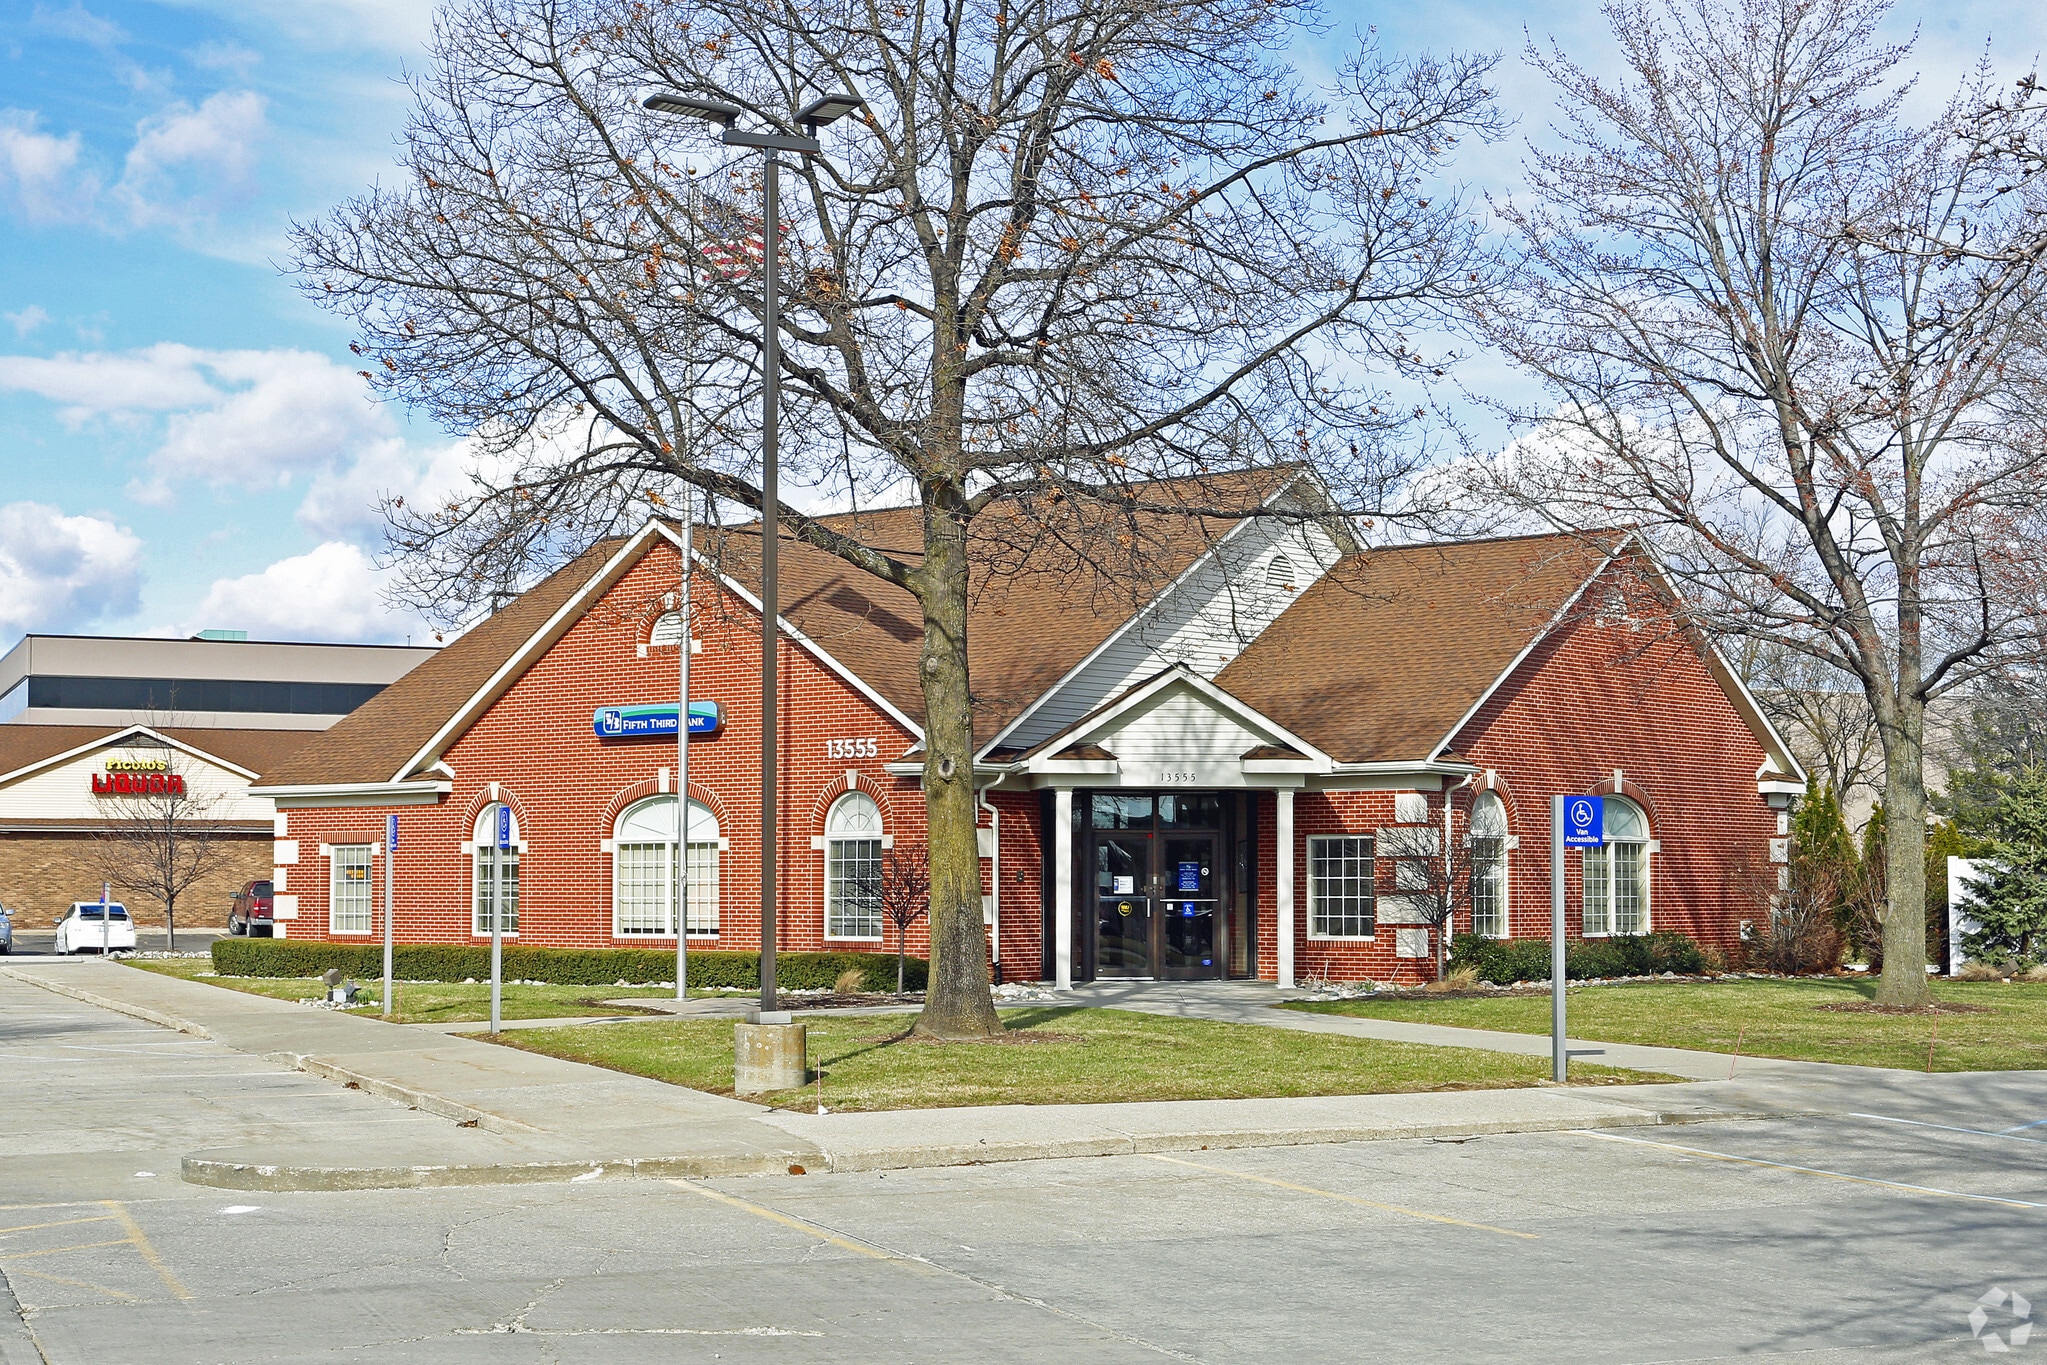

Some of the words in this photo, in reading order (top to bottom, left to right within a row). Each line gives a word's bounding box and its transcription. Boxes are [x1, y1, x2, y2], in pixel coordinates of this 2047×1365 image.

[623, 719, 648, 730] FIFTH
[649, 718, 677, 729] THIRD
[825, 738, 878, 759] 13555
[1160, 772, 1196, 782] 13555
[92, 773, 183, 794] LIQUOR
[1576, 828, 1589, 836] Van
[1565, 835, 1599, 843] Accessible
